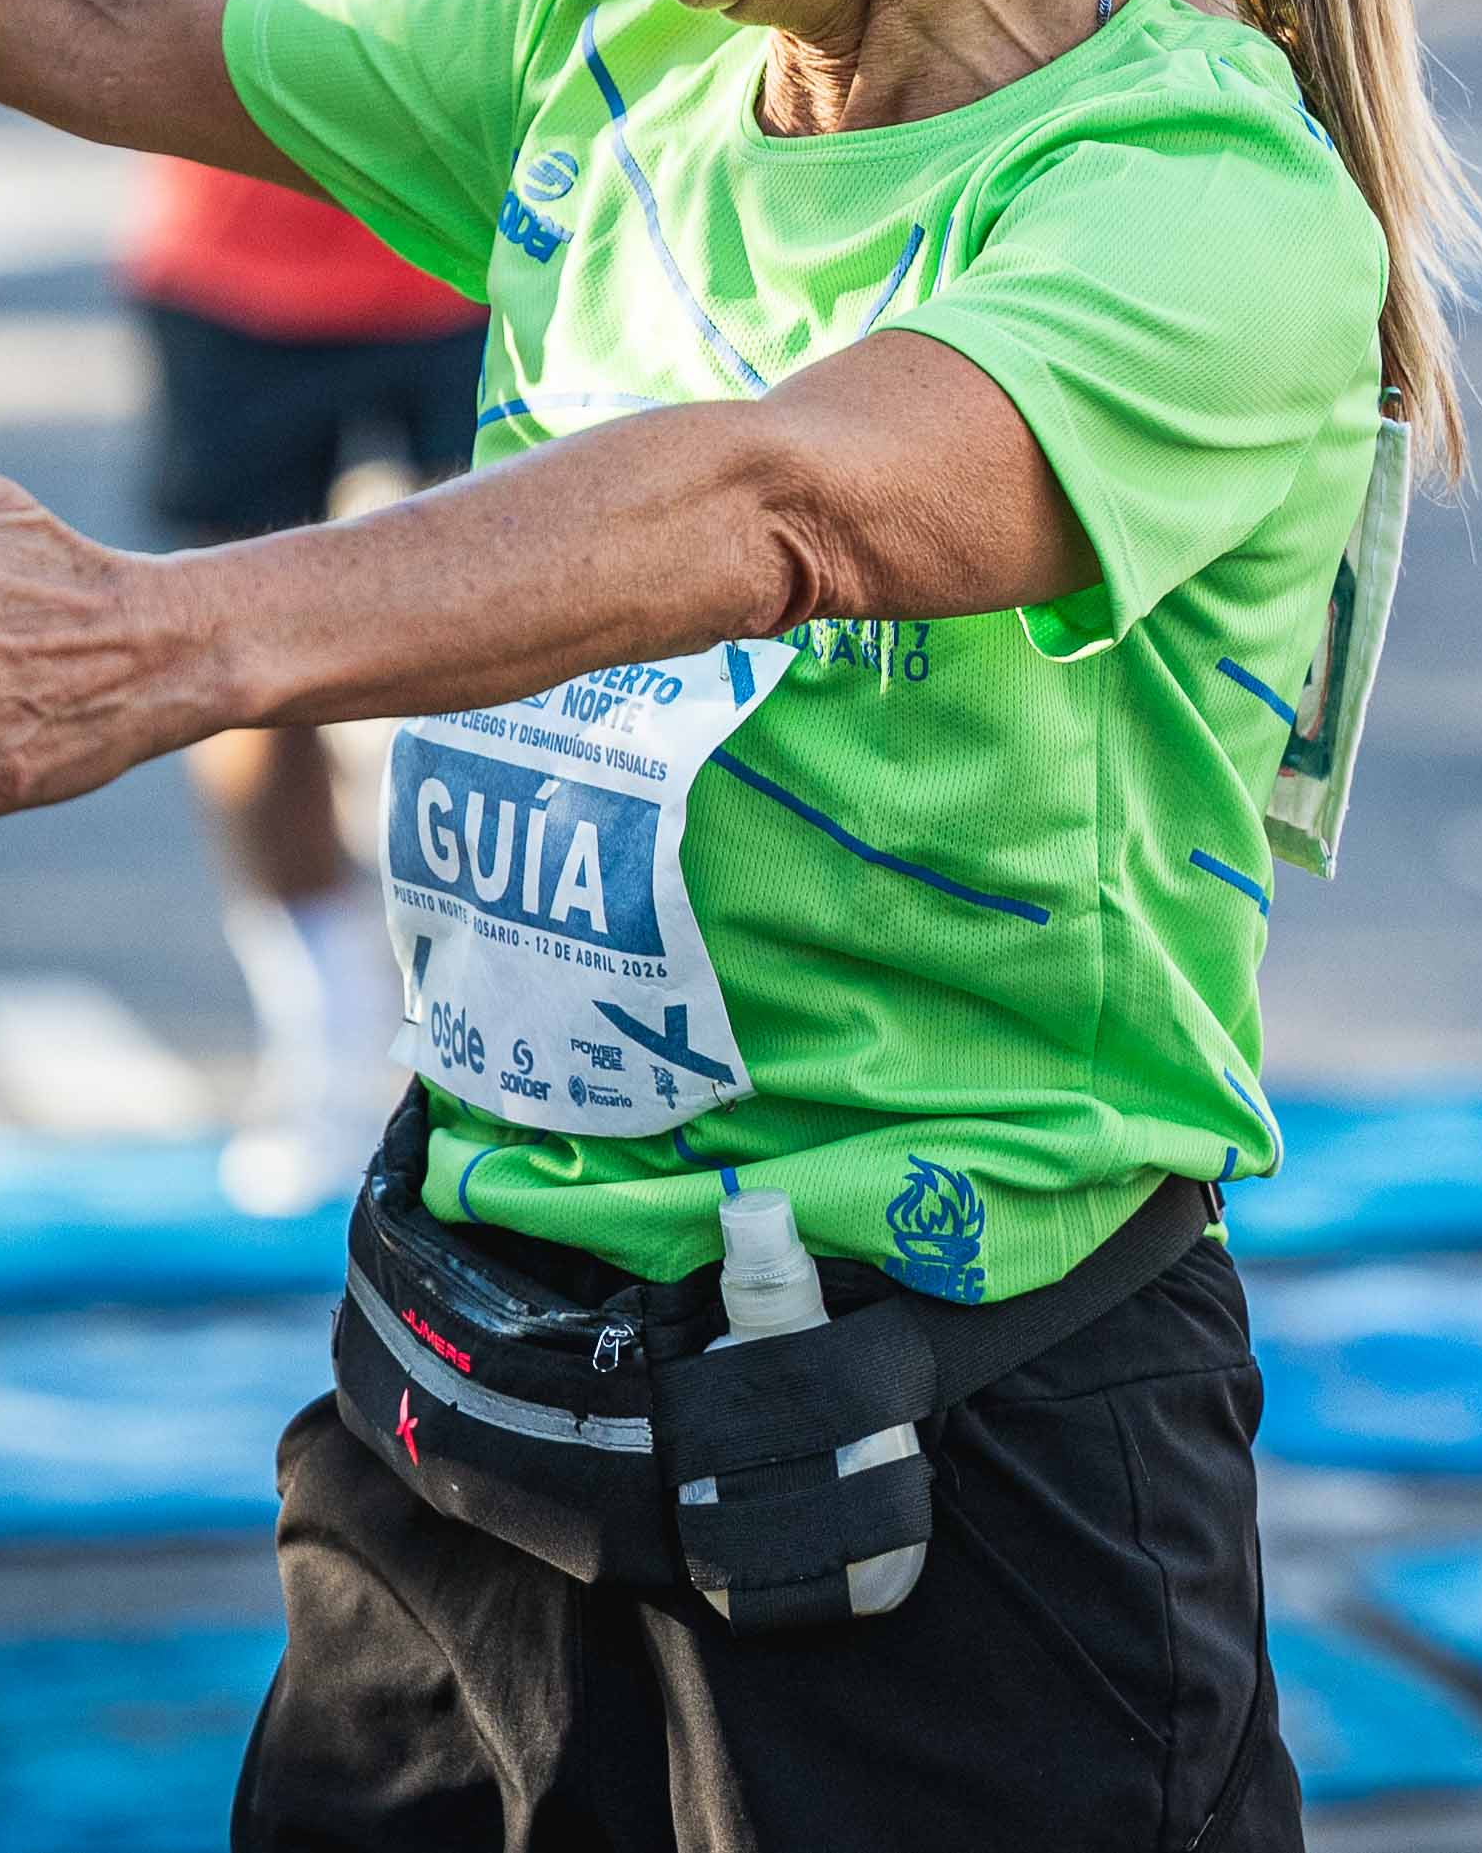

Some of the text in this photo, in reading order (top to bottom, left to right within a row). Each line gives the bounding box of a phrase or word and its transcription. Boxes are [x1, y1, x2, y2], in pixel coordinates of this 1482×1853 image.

[775, 622, 929, 681] OSARIO
[561, 683, 645, 735] NORTE
[587, 662, 683, 705] UERTO
[460, 711, 507, 738] CIEGOS
[508, 721, 519, 741] Y
[518, 724, 602, 765] DISMINUÍDOS
[606, 748, 668, 781] VISUALES
[417, 779, 609, 935] GUÍA
[393, 883, 435, 912] PUERTO
[437, 897, 468, 925] NORTE
[535, 935, 550, 955] 12
[554, 944, 572, 962] DE
[576, 951, 617, 974] ABRIL
[621, 959, 668, 979] 2026
[570, 1038, 623, 1060] POWER
[588, 1090, 633, 1109] Rosario
